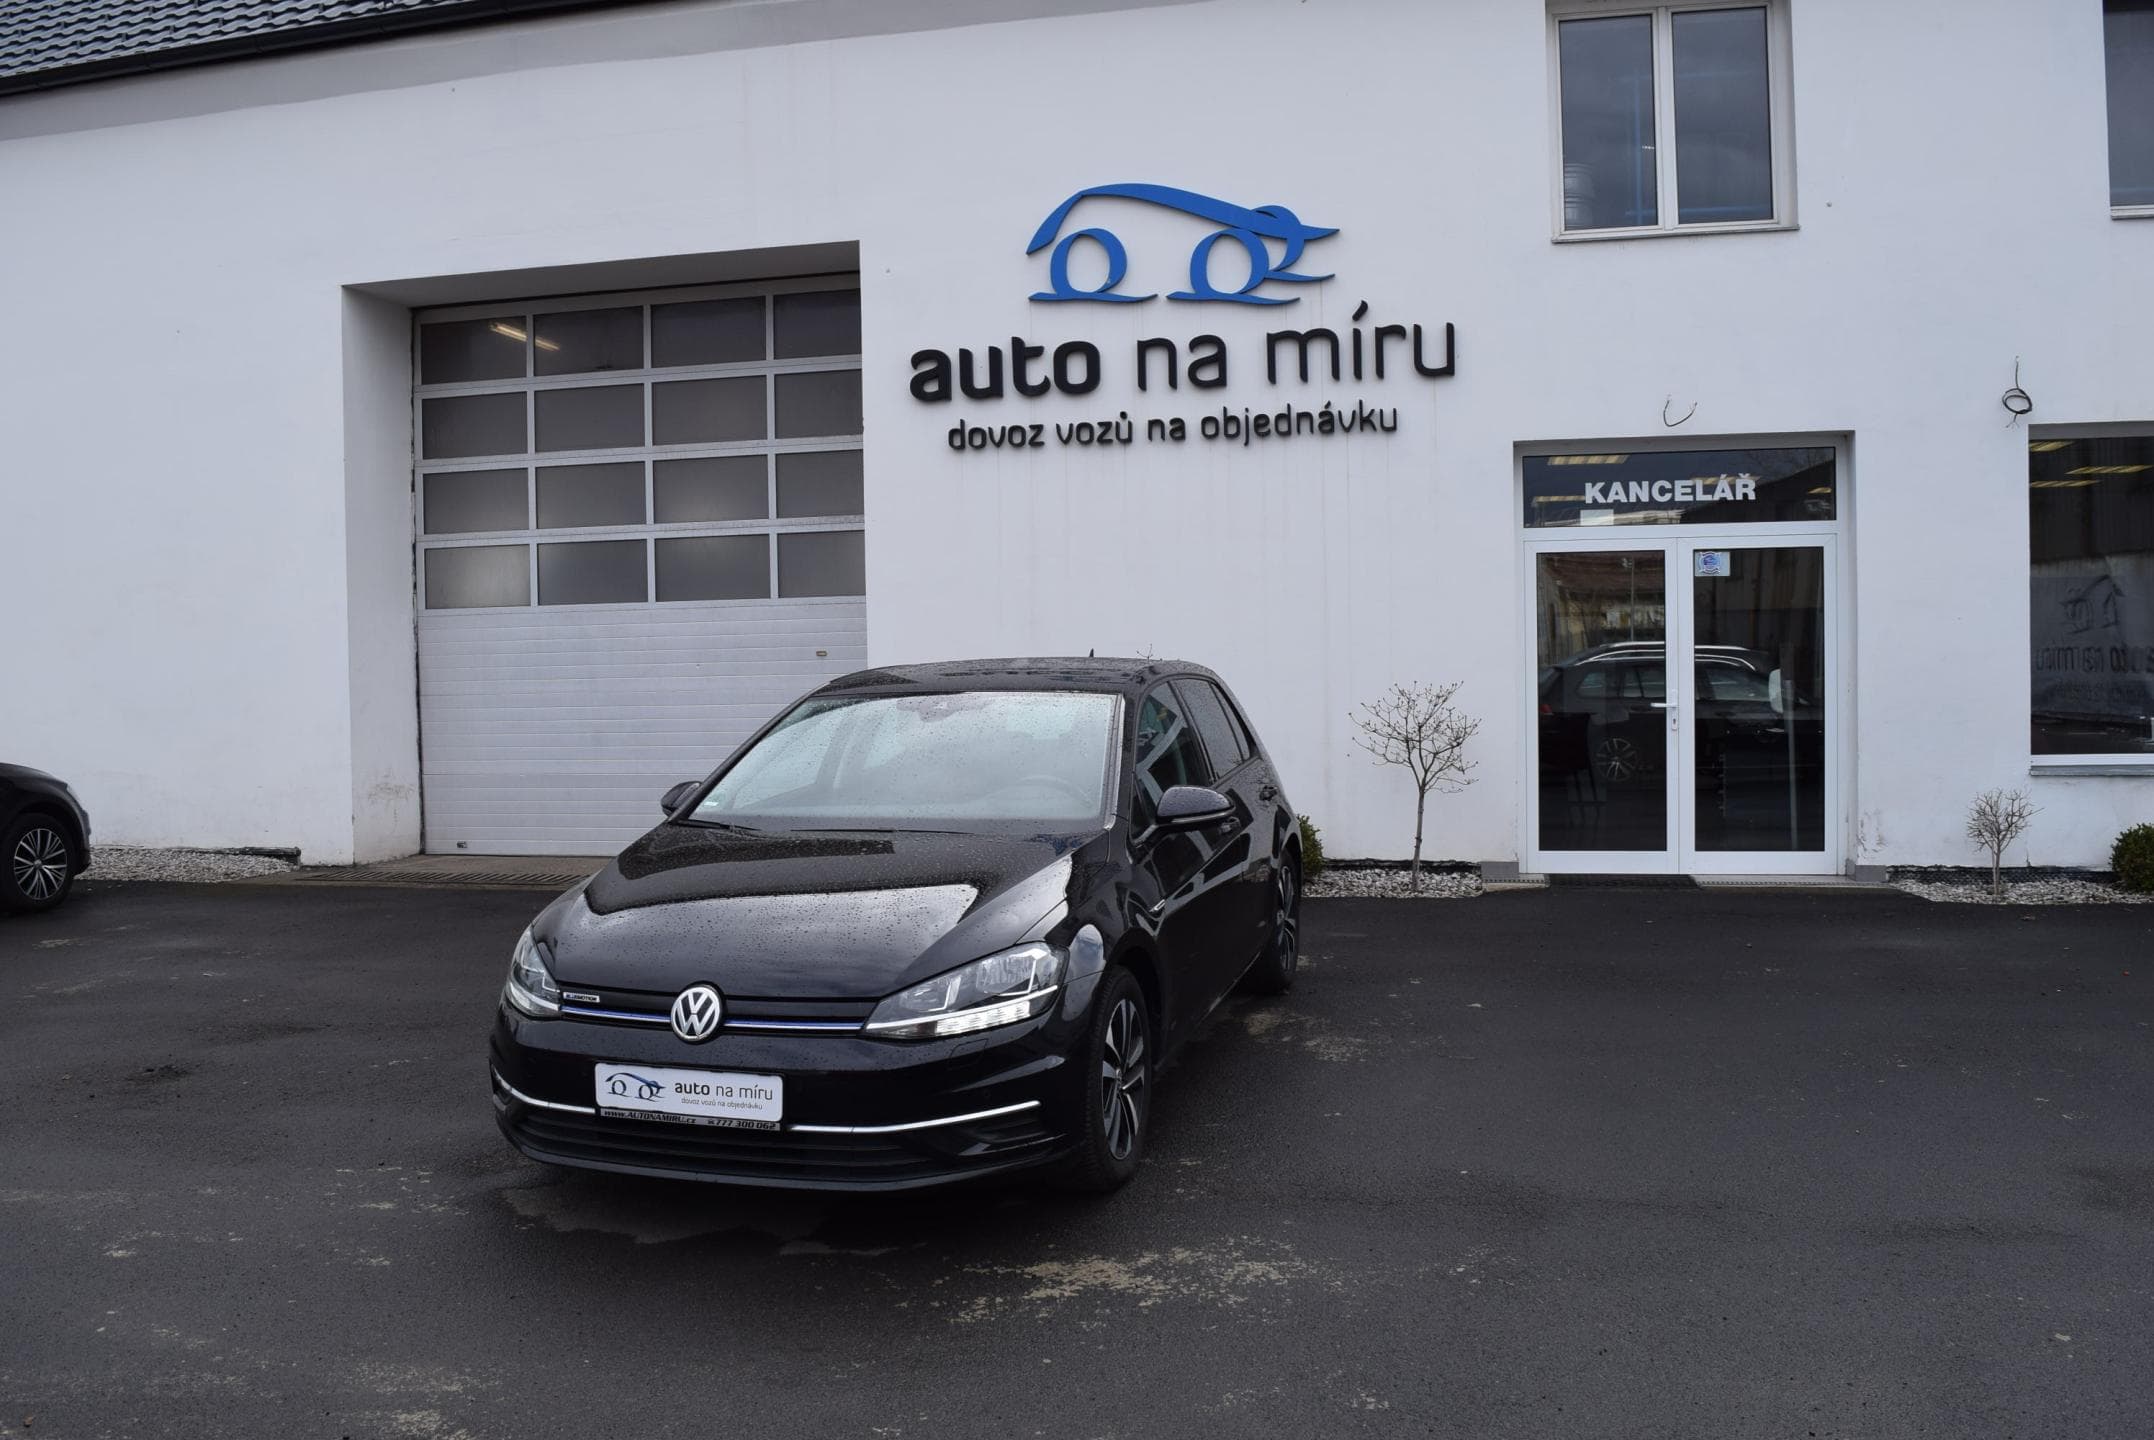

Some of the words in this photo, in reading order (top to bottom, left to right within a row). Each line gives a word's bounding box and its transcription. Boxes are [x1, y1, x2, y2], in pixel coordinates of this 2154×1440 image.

[909, 336, 1103, 403] auto
[1136, 333, 1228, 393] na
[1266, 300, 1456, 386] míru
[947, 418, 1046, 452] dovoz
[1056, 410, 1134, 448] vozů
[1147, 416, 1187, 443] na
[1200, 400, 1398, 448] objednávku
[1584, 473, 1757, 504] KANCELÁŘ
[672, 987, 719, 1039] VW
[674, 1081, 710, 1096] auto
[715, 1084, 733, 1098] na
[739, 1084, 773, 1100] míru
[681, 1097, 700, 1105] dovoz
[701, 1098, 717, 1107] vozů
[717, 1100, 726, 1108] na
[727, 1099, 763, 1110] objednávku
[715, 1118, 734, 1128] 777
